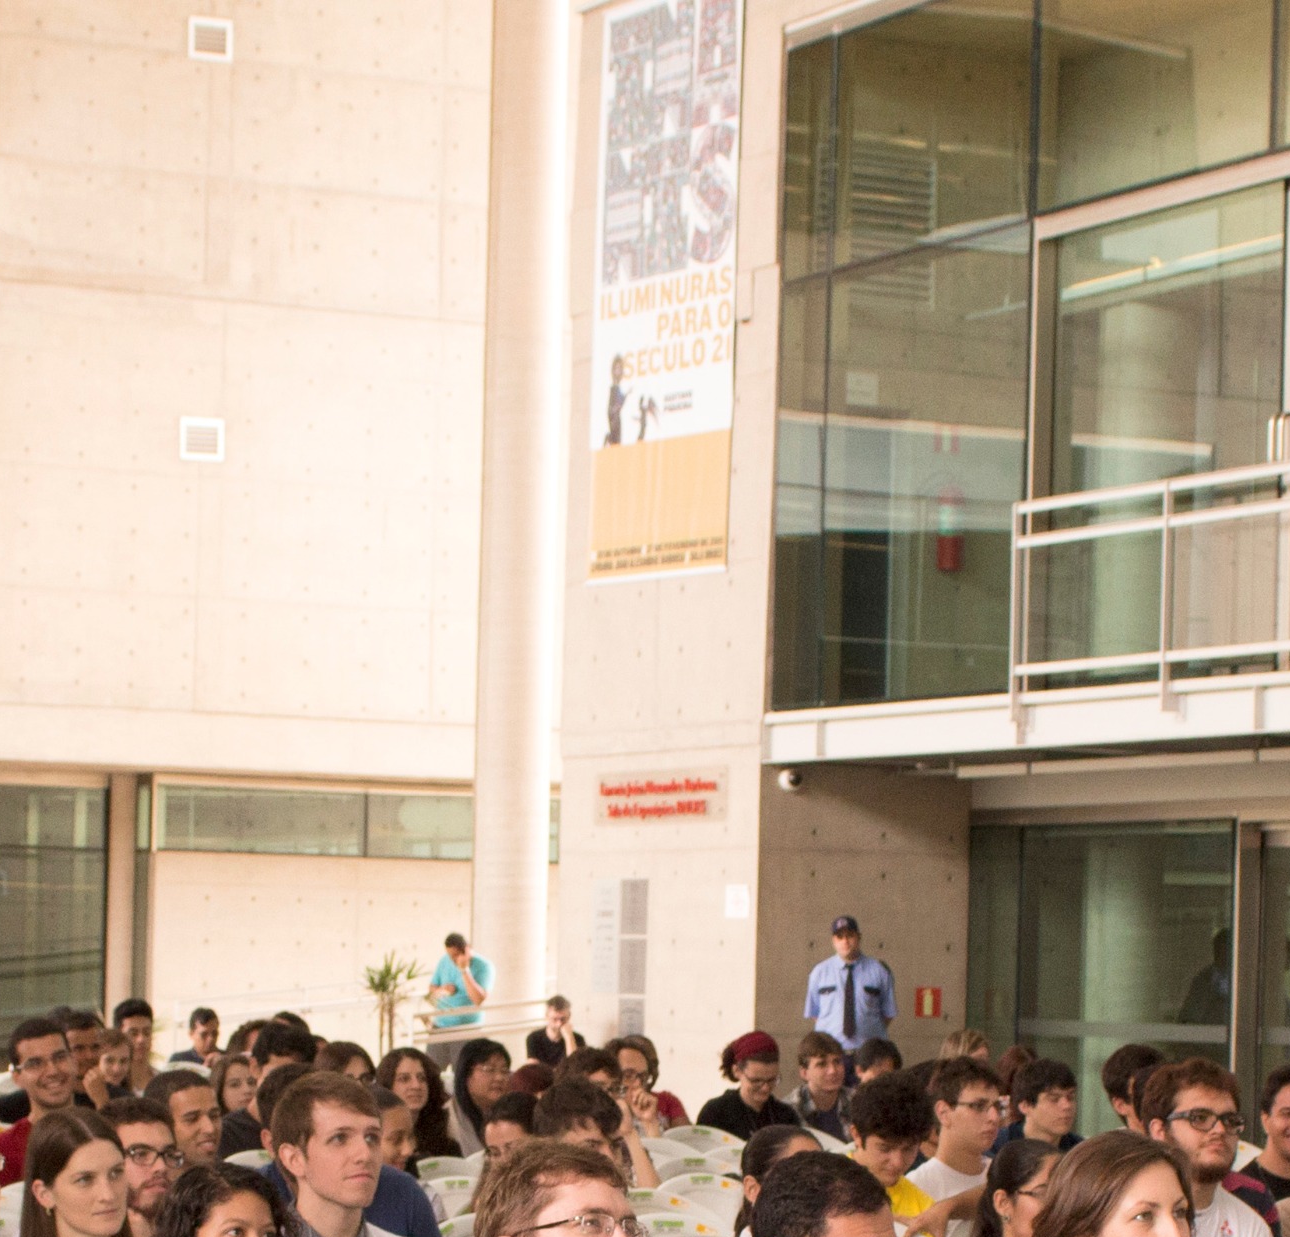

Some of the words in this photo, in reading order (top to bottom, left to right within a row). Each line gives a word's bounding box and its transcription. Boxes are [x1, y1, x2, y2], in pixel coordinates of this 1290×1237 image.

[600, 267, 732, 320] ILUMINURAS
[656, 305, 712, 342] PARA
[718, 300, 731, 328] O
[711, 334, 731, 363] 21
